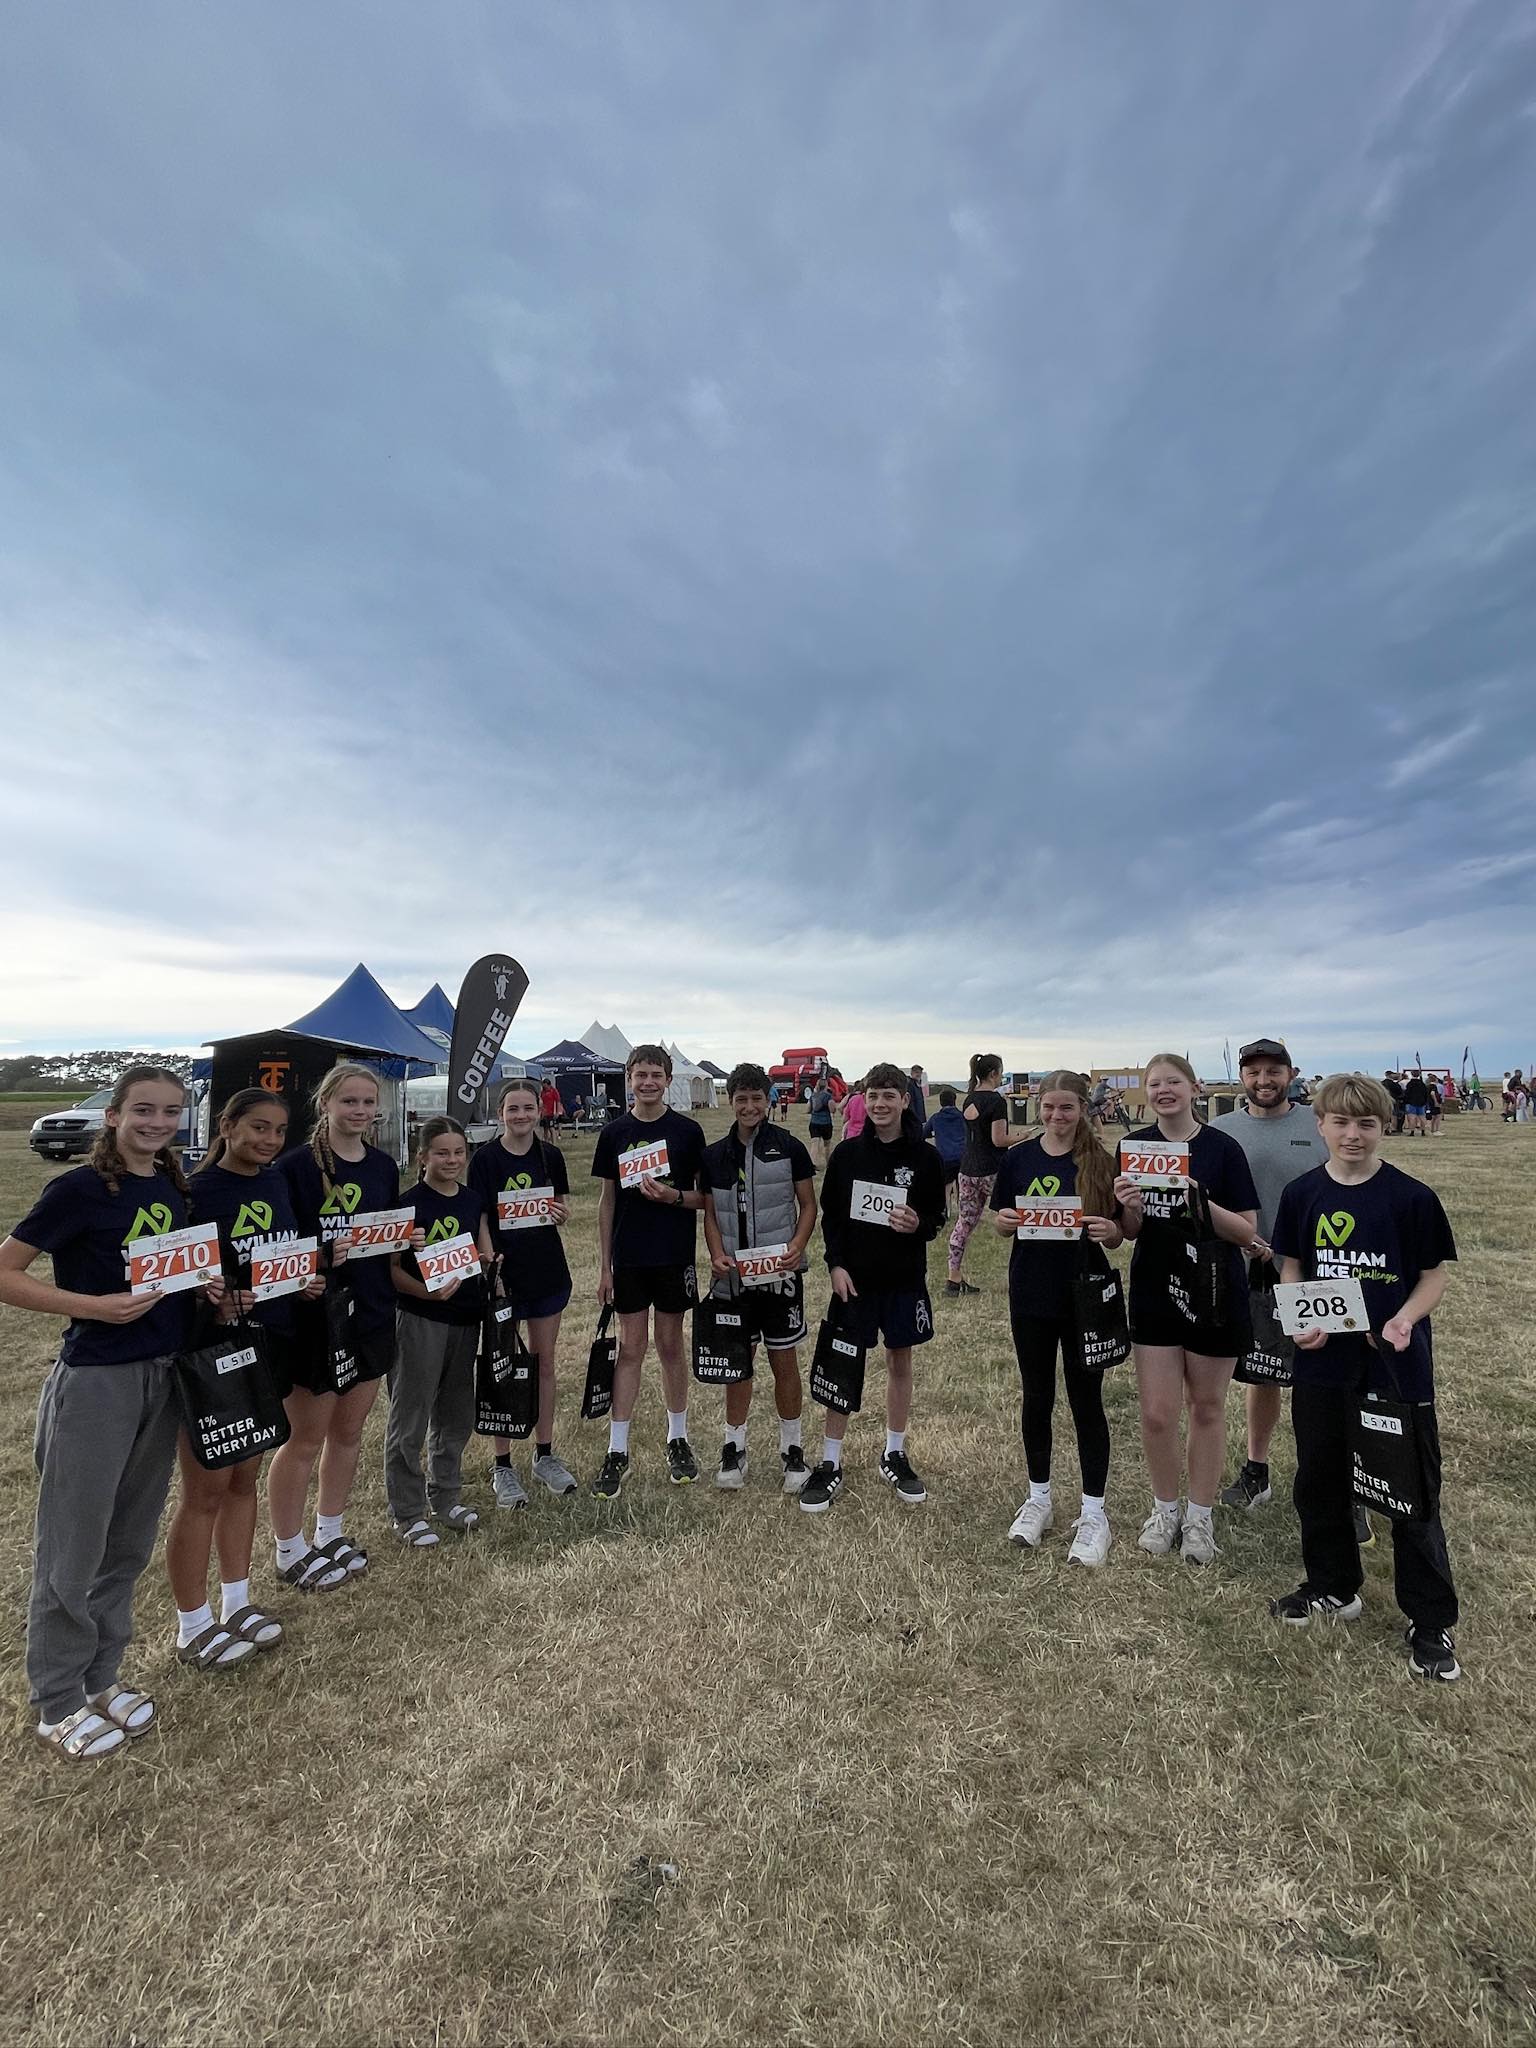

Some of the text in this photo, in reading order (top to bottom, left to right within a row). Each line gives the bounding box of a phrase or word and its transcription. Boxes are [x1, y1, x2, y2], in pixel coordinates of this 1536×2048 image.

[457, 1007, 511, 1104] COFFEE
[625, 1152, 660, 1175] 2711
[1127, 1153, 1181, 1174] 2702
[505, 1198, 549, 1218] 2706
[861, 1194, 894, 1214] 209
[1142, 1191, 1185, 1207] ILLIA
[1023, 1209, 1075, 1226] 2705
[357, 1221, 409, 1245] 2707
[141, 1243, 210, 1281] 2710
[260, 1254, 311, 1284] 2708
[425, 1246, 473, 1277] 2703
[1352, 1266, 1399, 1284] Challenge
[1168, 1284, 1190, 1304] BETT
[1295, 1296, 1348, 1318] 208
[1084, 1331, 1098, 1341] 1%
[1084, 1338, 1117, 1354] BETTER
[699, 1356, 729, 1367] BETTER
[1086, 1344, 1126, 1366] EVERY DAY
[698, 1366, 742, 1378] EVERY DAY
[1245, 1361, 1292, 1380] EVERY DAY
[814, 1374, 839, 1393] BETTER
[812, 1384, 849, 1409] EVERY DAY
[198, 1415, 217, 1429] 1%
[477, 1420, 526, 1433] EVERY DAY
[480, 1411, 512, 1422] BETTER
[201, 1417, 255, 1444] BETTER
[205, 1425, 277, 1460] EVERY DAY
[1353, 1466, 1391, 1493] BETTER
[1353, 1480, 1413, 1515] EVERY DAY
